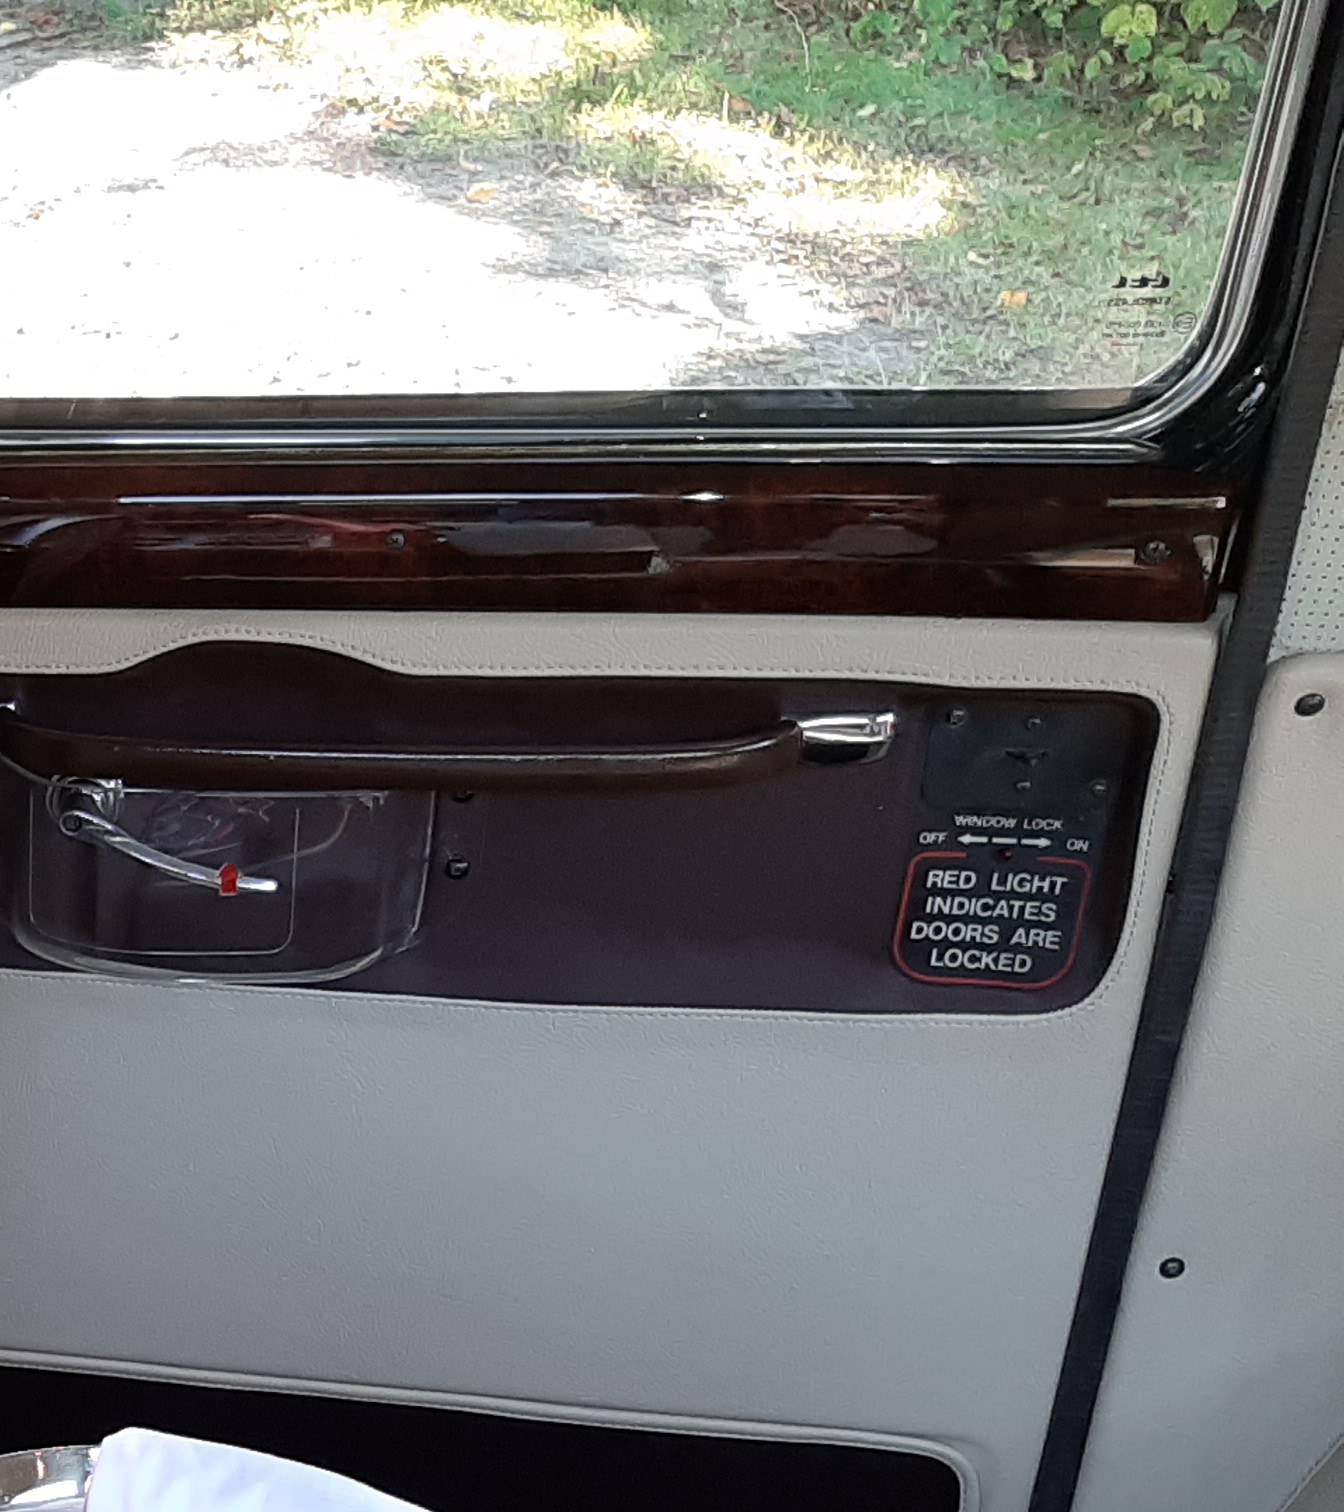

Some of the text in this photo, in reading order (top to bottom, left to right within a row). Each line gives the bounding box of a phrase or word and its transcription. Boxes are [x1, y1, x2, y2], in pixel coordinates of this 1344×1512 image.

[953, 814, 1064, 831] WINDOW LOCK
[919, 832, 1089, 852] OFF ON
[926, 870, 1069, 895] RED LIGHT
[926, 897, 1057, 921] INDICATES
[911, 922, 1062, 950] DOORS ARE
[931, 949, 1032, 973] LOCKED
